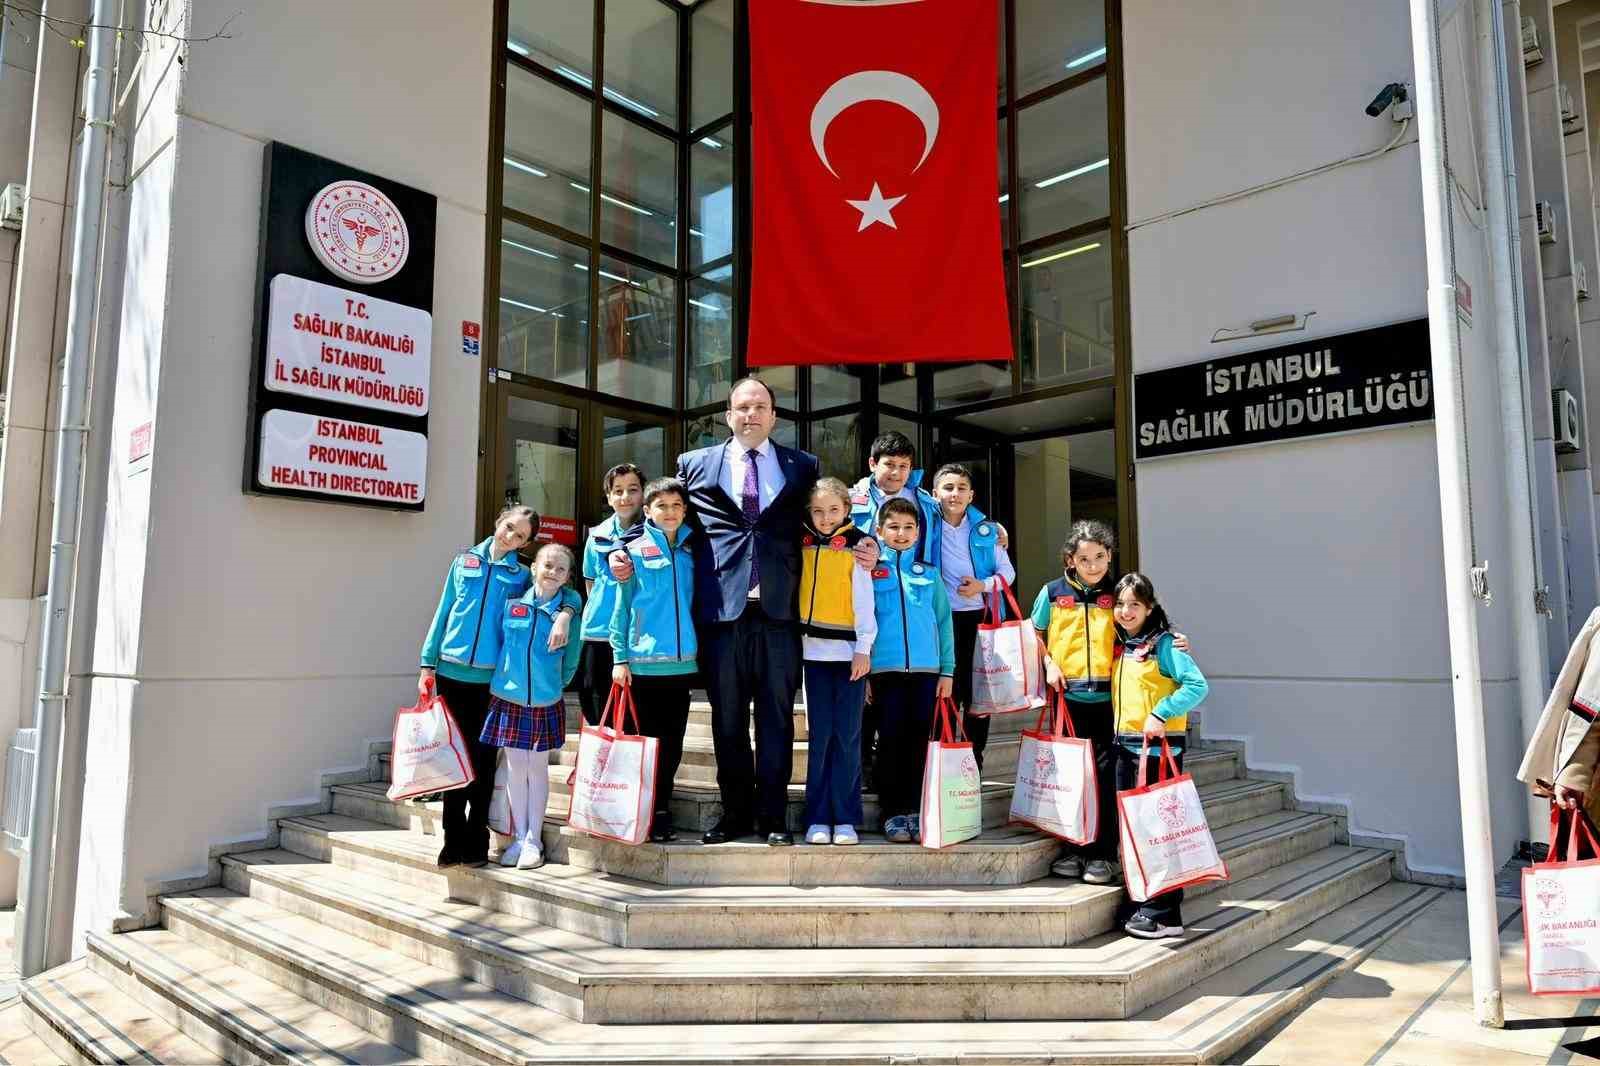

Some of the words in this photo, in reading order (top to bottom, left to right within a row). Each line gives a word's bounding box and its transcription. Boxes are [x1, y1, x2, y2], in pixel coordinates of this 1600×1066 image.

[345, 299, 369, 320] T.C.
[293, 313, 344, 339] SAĞLIK
[346, 325, 414, 355] BAKANLIĞI
[320, 342, 386, 374] İSTANBUL
[1205, 349, 1341, 397] İSTANBUL
[275, 359, 288, 382] İL
[291, 367, 341, 392] SAĞLIK
[345, 377, 424, 407] MÜDÜRLÜĞÜ
[1139, 409, 1232, 447] SAĞLIK
[1244, 370, 1430, 432] MÜDÜRLÜĞÜ
[309, 445, 388, 471] PROVINCIAL
[271, 466, 327, 489] HEALTH
[331, 474, 418, 500] DIRECTORATE
